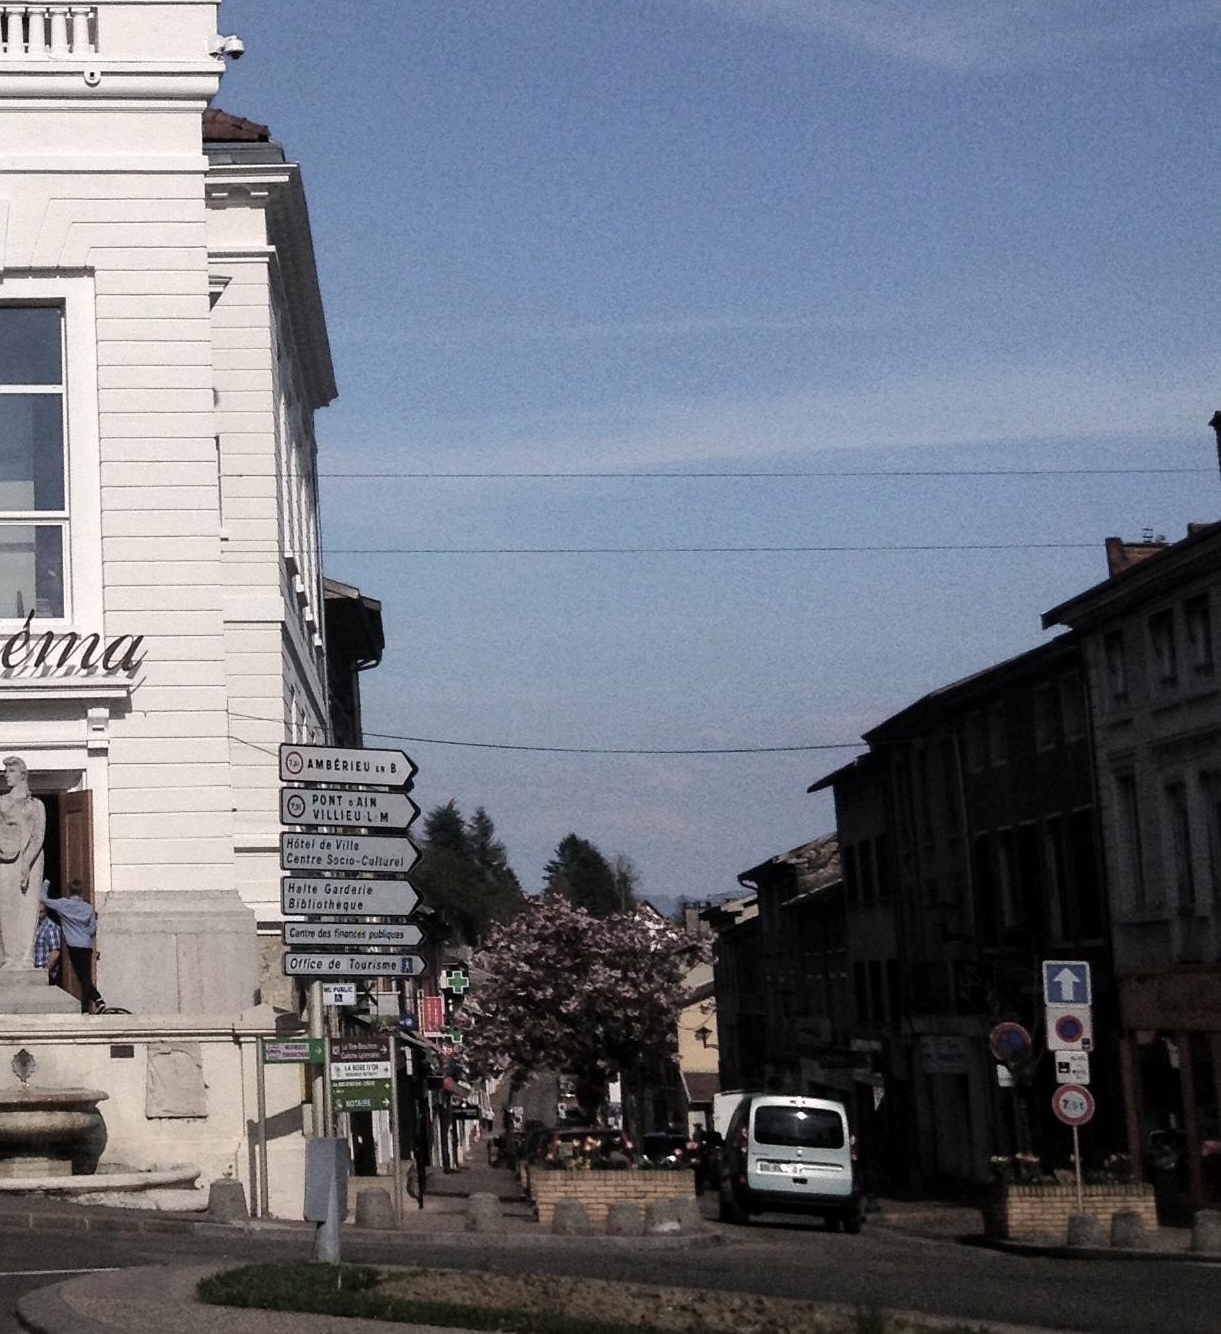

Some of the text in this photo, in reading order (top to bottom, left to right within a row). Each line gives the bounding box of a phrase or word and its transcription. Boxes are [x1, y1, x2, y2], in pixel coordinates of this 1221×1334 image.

[307, 758, 370, 772] AMBÉRIEU
[312, 794, 343, 806] PONT
[313, 809, 361, 821] VILLIEU
[286, 838, 359, 851] Hôtel de Ville
[286, 853, 404, 867] Centre Socio-Culturel
[287, 882, 373, 895] Halte Garderie
[289, 927, 404, 941] Centre des finances publiques
[290, 957, 397, 970] Office de Tourisme
